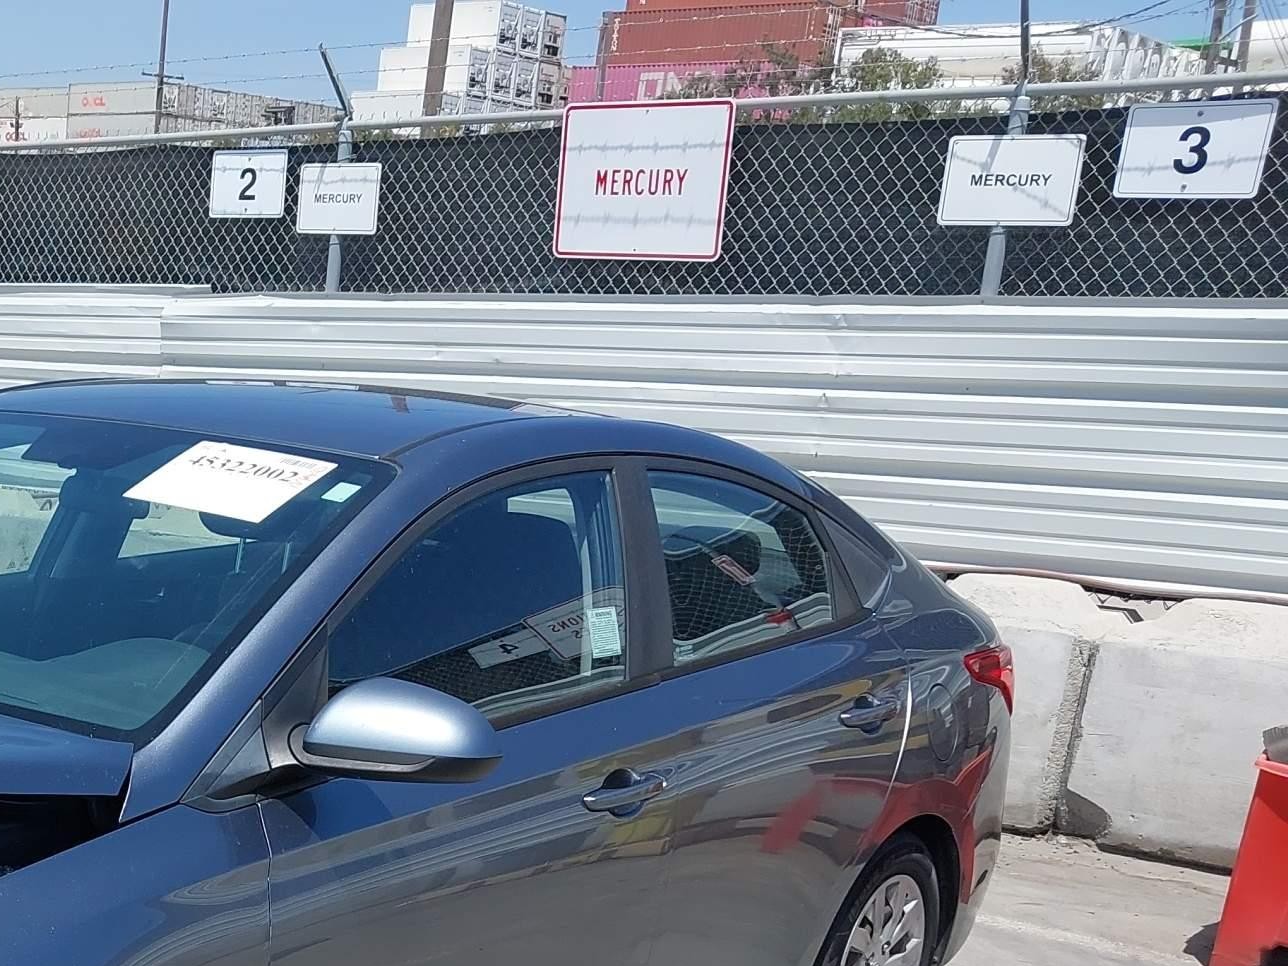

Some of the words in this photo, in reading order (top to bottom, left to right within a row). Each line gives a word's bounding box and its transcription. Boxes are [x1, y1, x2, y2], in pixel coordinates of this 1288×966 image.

[1173, 126, 1211, 175] 3
[238, 167, 257, 201] 2
[595, 169, 689, 196] MERCURY
[970, 174, 1052, 187] MERCURY
[314, 193, 362, 204] MERCURY
[189, 455, 299, 483] 45322002
